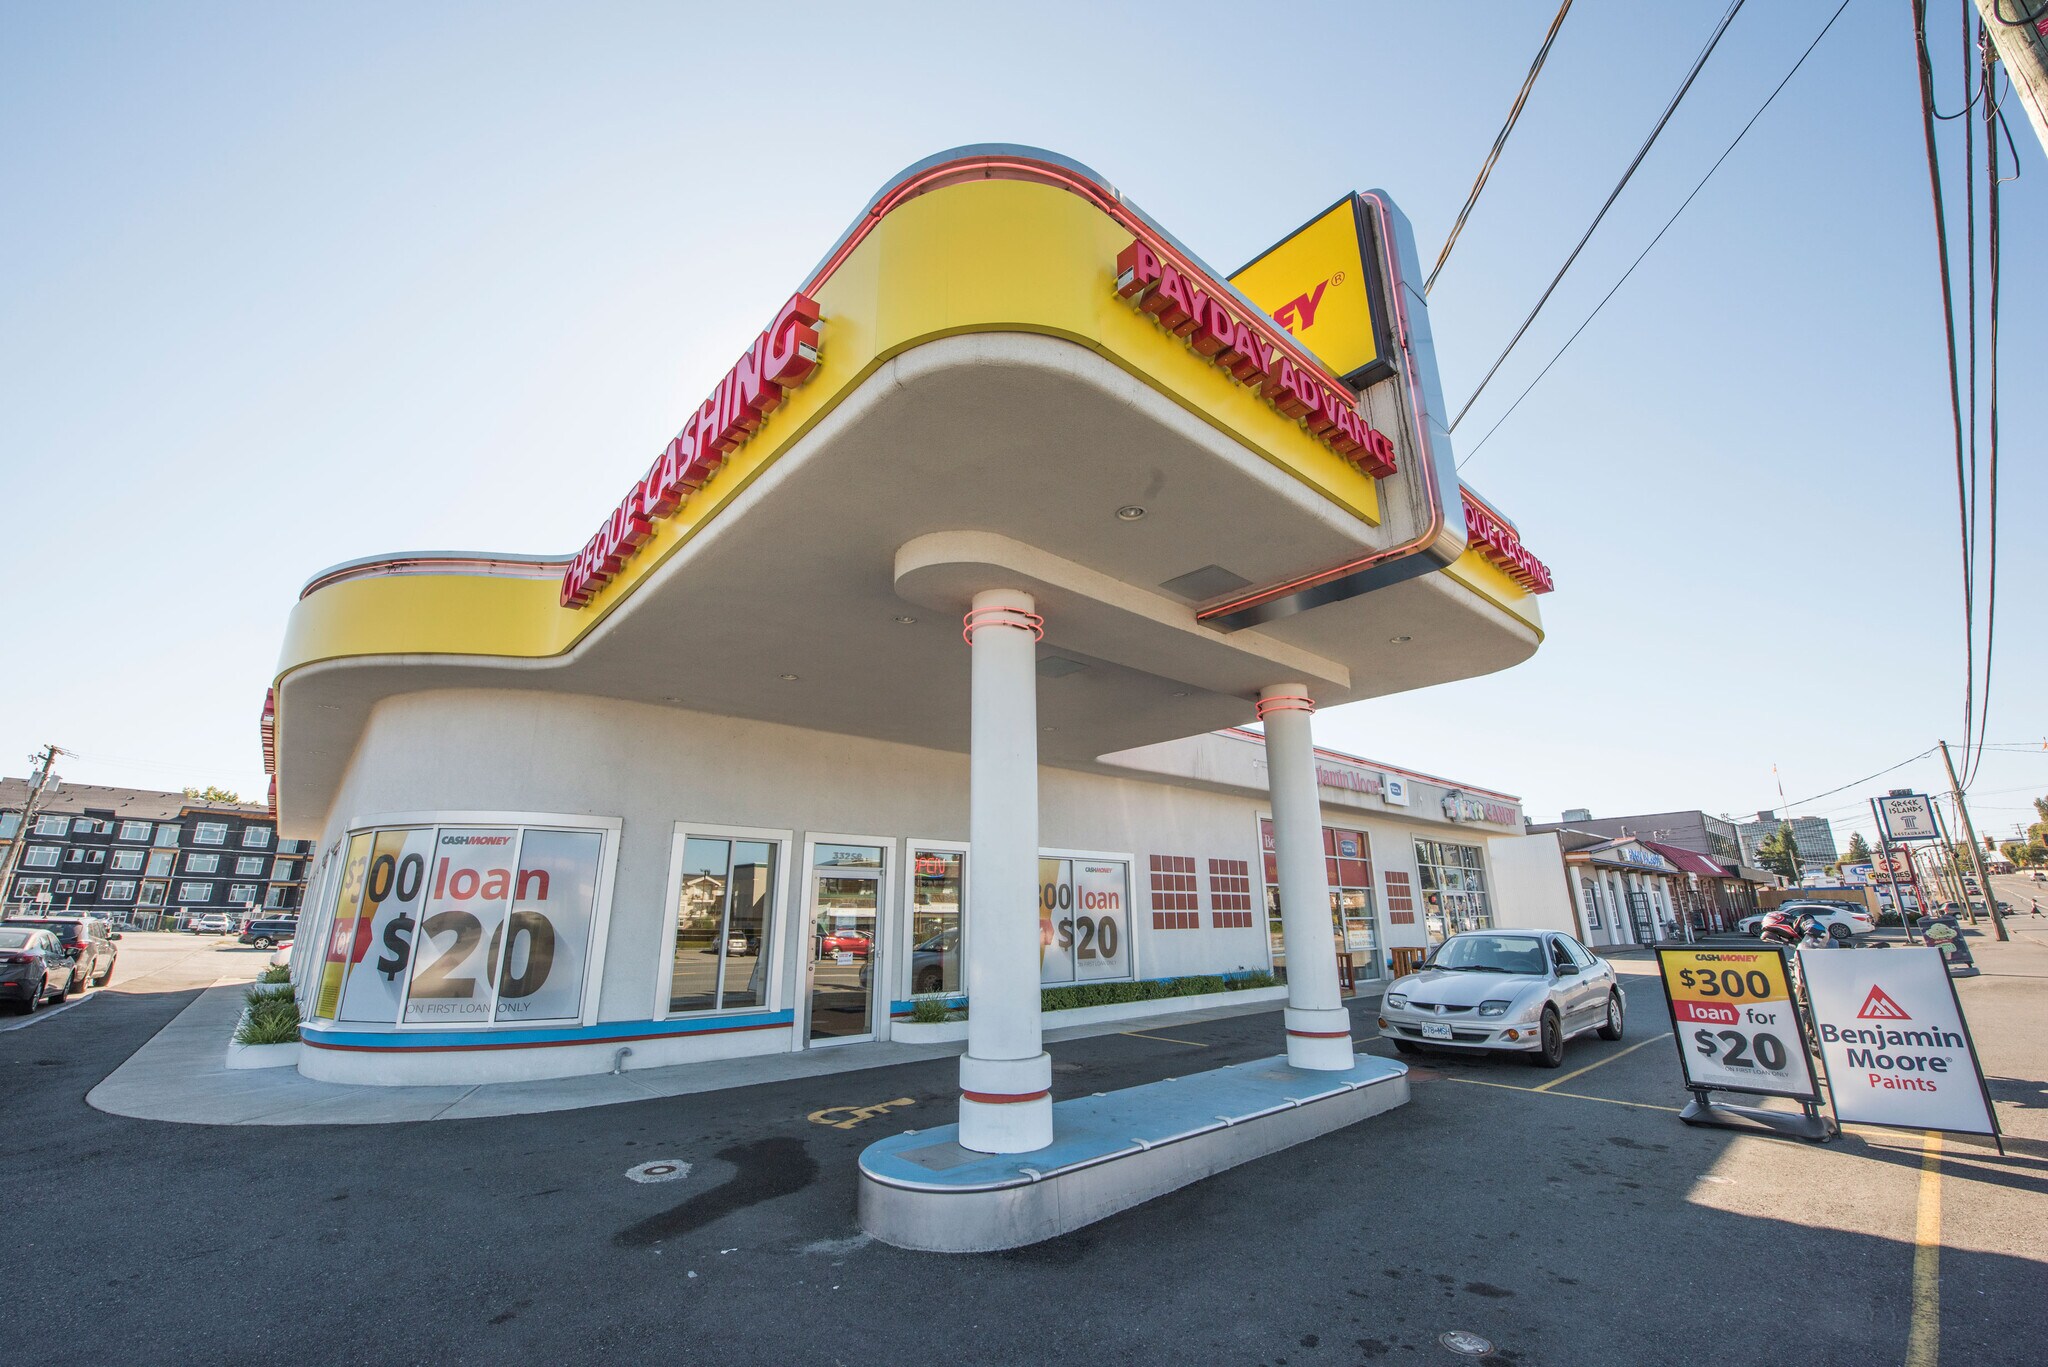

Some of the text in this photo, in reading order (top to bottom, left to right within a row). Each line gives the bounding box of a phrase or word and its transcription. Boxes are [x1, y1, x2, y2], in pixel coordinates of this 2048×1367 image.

[1118, 239, 1397, 479] PAYDAY ADVANCE
[560, 291, 820, 609] CHEQUE CASHING
[1488, 529, 1554, 594] CASHING
[1485, 803, 1516, 825] CANDY
[1889, 806, 1923, 814] ISLANDS
[1891, 799, 1918, 807] GREEK
[1879, 852, 1897, 860] OE
[433, 856, 551, 901] loan
[1078, 885, 1119, 910] loan
[1058, 915, 1118, 960] $20
[377, 911, 556, 999] $20
[1695, 953, 1759, 963] CASHMONEY
[1679, 968, 1771, 999] $300
[405, 1002, 532, 1014] ON FIRST LOAN ONLY
[1688, 1003, 1776, 1025] loan for
[1820, 1024, 1964, 1050] Benjamin
[1694, 1029, 1787, 1071] $20
[1724, 1065, 1735, 1073] ON
[1868, 1073, 1937, 1093] Paints
